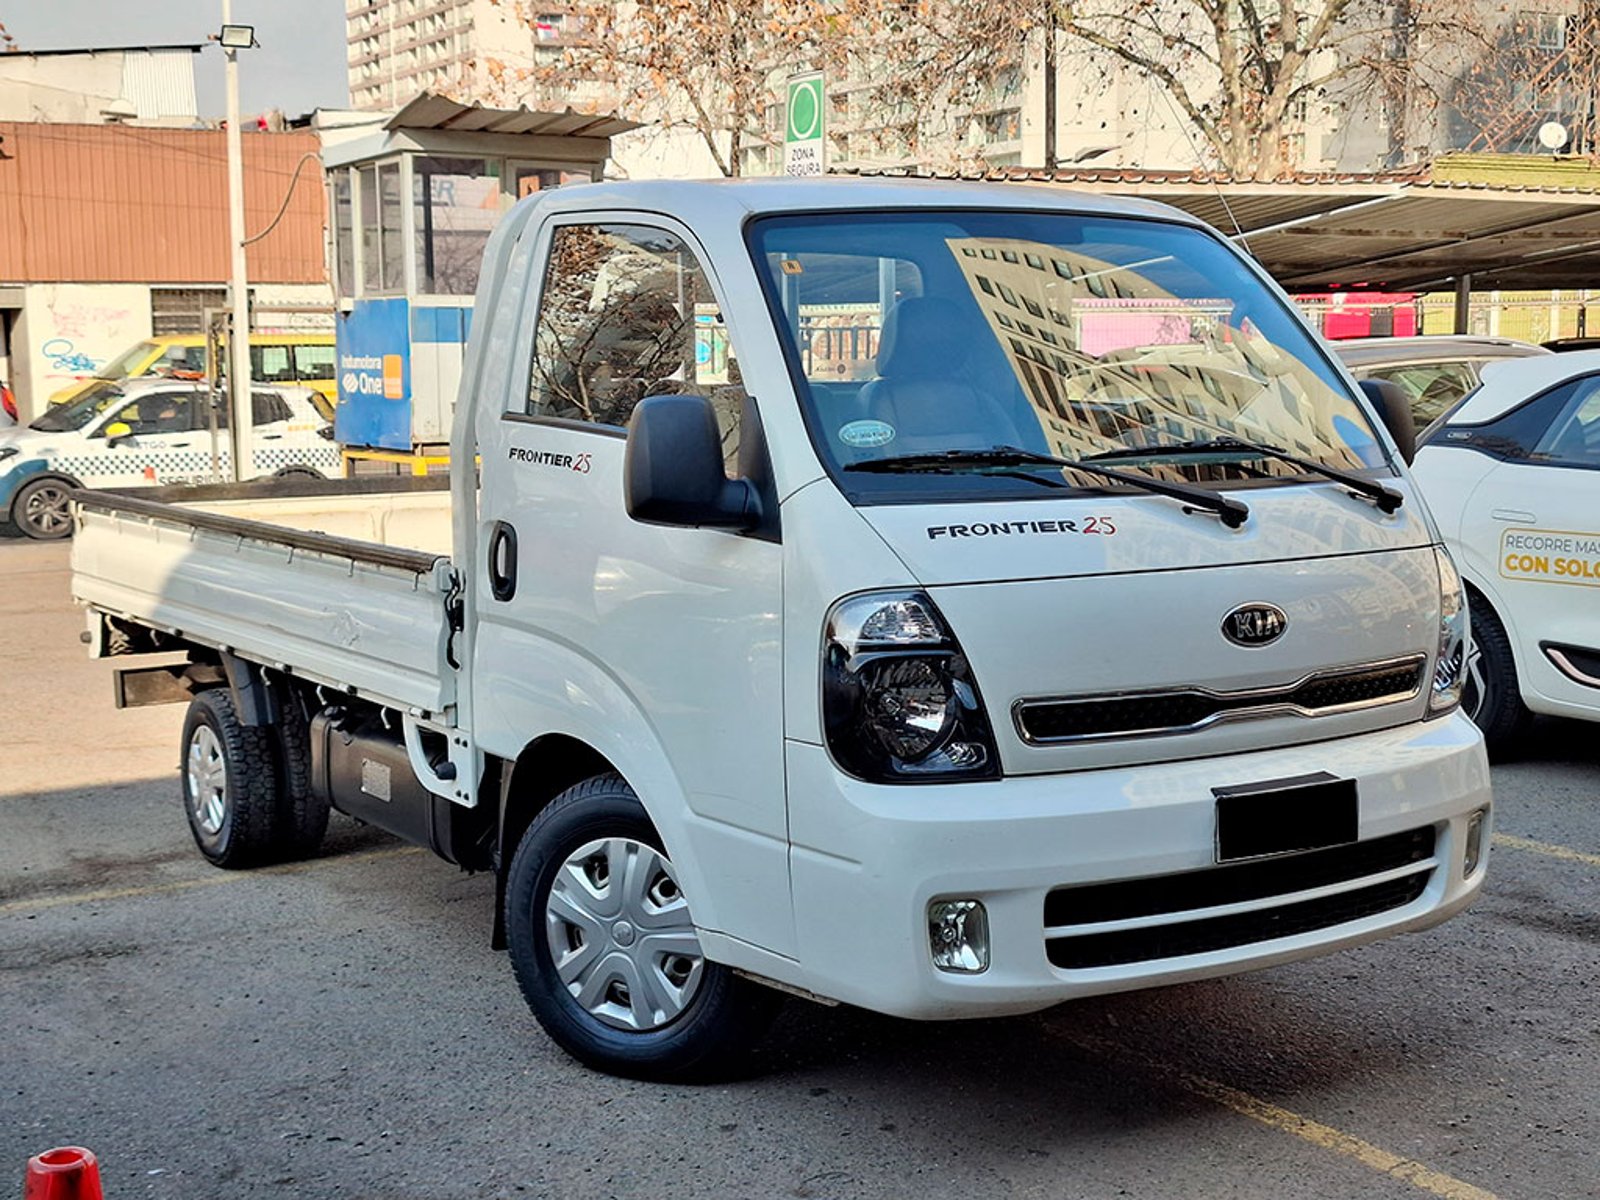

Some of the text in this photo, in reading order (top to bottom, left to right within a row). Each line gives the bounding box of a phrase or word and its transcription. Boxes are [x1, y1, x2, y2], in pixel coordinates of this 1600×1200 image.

[792, 148, 814, 161] ZONA
[786, 162, 821, 177] SEGURA
[360, 372, 382, 395] One
[509, 447, 593, 474] FRONTIER 25
[927, 516, 1116, 540] FRONTIER 25
[1505, 534, 1572, 553] RECORRE
[1505, 553, 1549, 574] CON
[1233, 610, 1281, 638] KIA
